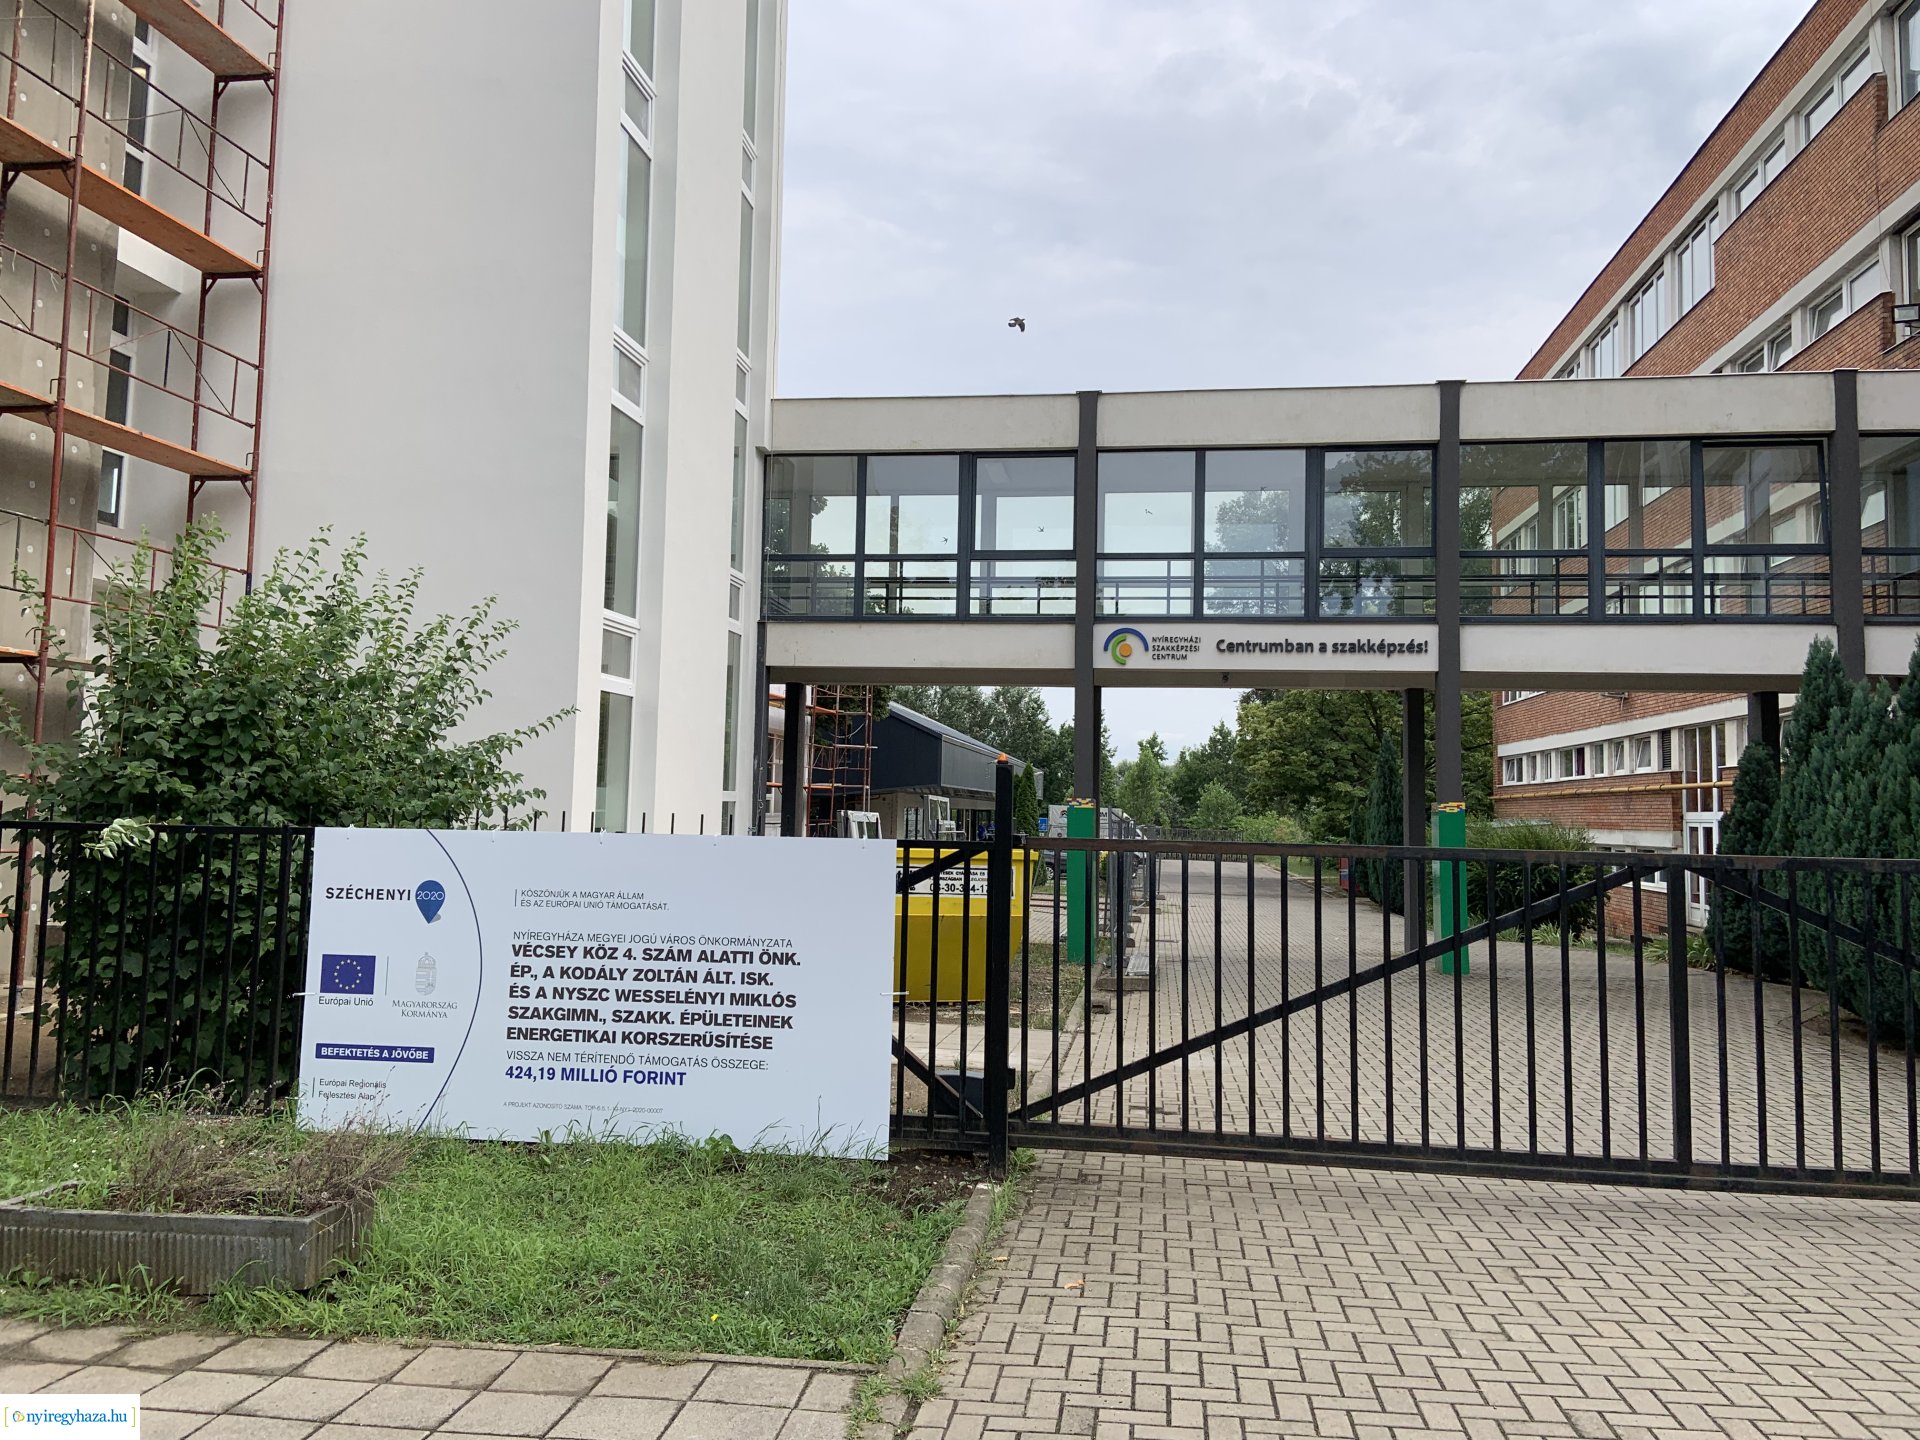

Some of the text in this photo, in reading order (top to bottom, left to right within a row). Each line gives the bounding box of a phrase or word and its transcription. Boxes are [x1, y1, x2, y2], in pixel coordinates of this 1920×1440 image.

[1152, 635, 1201, 644] NYÍREGYHÁZI
[1152, 644, 1200, 652] SZAKKÉPZÉSI
[1216, 639, 1429, 657] Centrumban a szakképzés!
[1152, 653, 1188, 661] CENTRUM
[325, 885, 444, 901] SZÉCHENYI 2020
[521, 890, 570, 898] KÖSZÖNJÜK
[580, 891, 615, 899] MAGYAR
[617, 891, 644, 899] ÁLLAM
[546, 900, 582, 908] EURÓPAI
[584, 900, 604, 908] UNIÓ
[606, 901, 669, 910] TÁMOGATÁSÁT.
[513, 931, 792, 948] NYÍREGYHÁZA MEGYEI JOGÚ VÁROS ÖNKORMÁNYZATA
[512, 942, 800, 966] VÉCSEY KÖZ 4. SZÁM ALATTI ÖNK.
[510, 963, 773, 986] ÉP., A KODÁLY ZOLTÁN ÁLT. ISK.
[318, 996, 373, 1007] Európai Unió
[509, 985, 796, 1008] ÉS A NYSZC WESSELÉNYI MIKLÓS
[392, 1000, 458, 1010] MAGYARORSZÁG
[401, 1009, 448, 1019] KORMÁNYA
[508, 1006, 793, 1029] SZAKGIMN., SZAKK. ÉPÜLETEINEK
[506, 1027, 773, 1050] ENERGETIKAI KORSZERŰSÍTÉSE
[321, 1047, 380, 1058] BEFEKTETÉS
[383, 1050, 389, 1058] A
[506, 1051, 768, 1070] VISSZA NEM TÉRÍTENDŐ TÁMOGATÁS ÖSSZEGE:
[505, 1065, 686, 1086] 424,19 MILLIÓ FORINT
[320, 1079, 347, 1087] Európai
